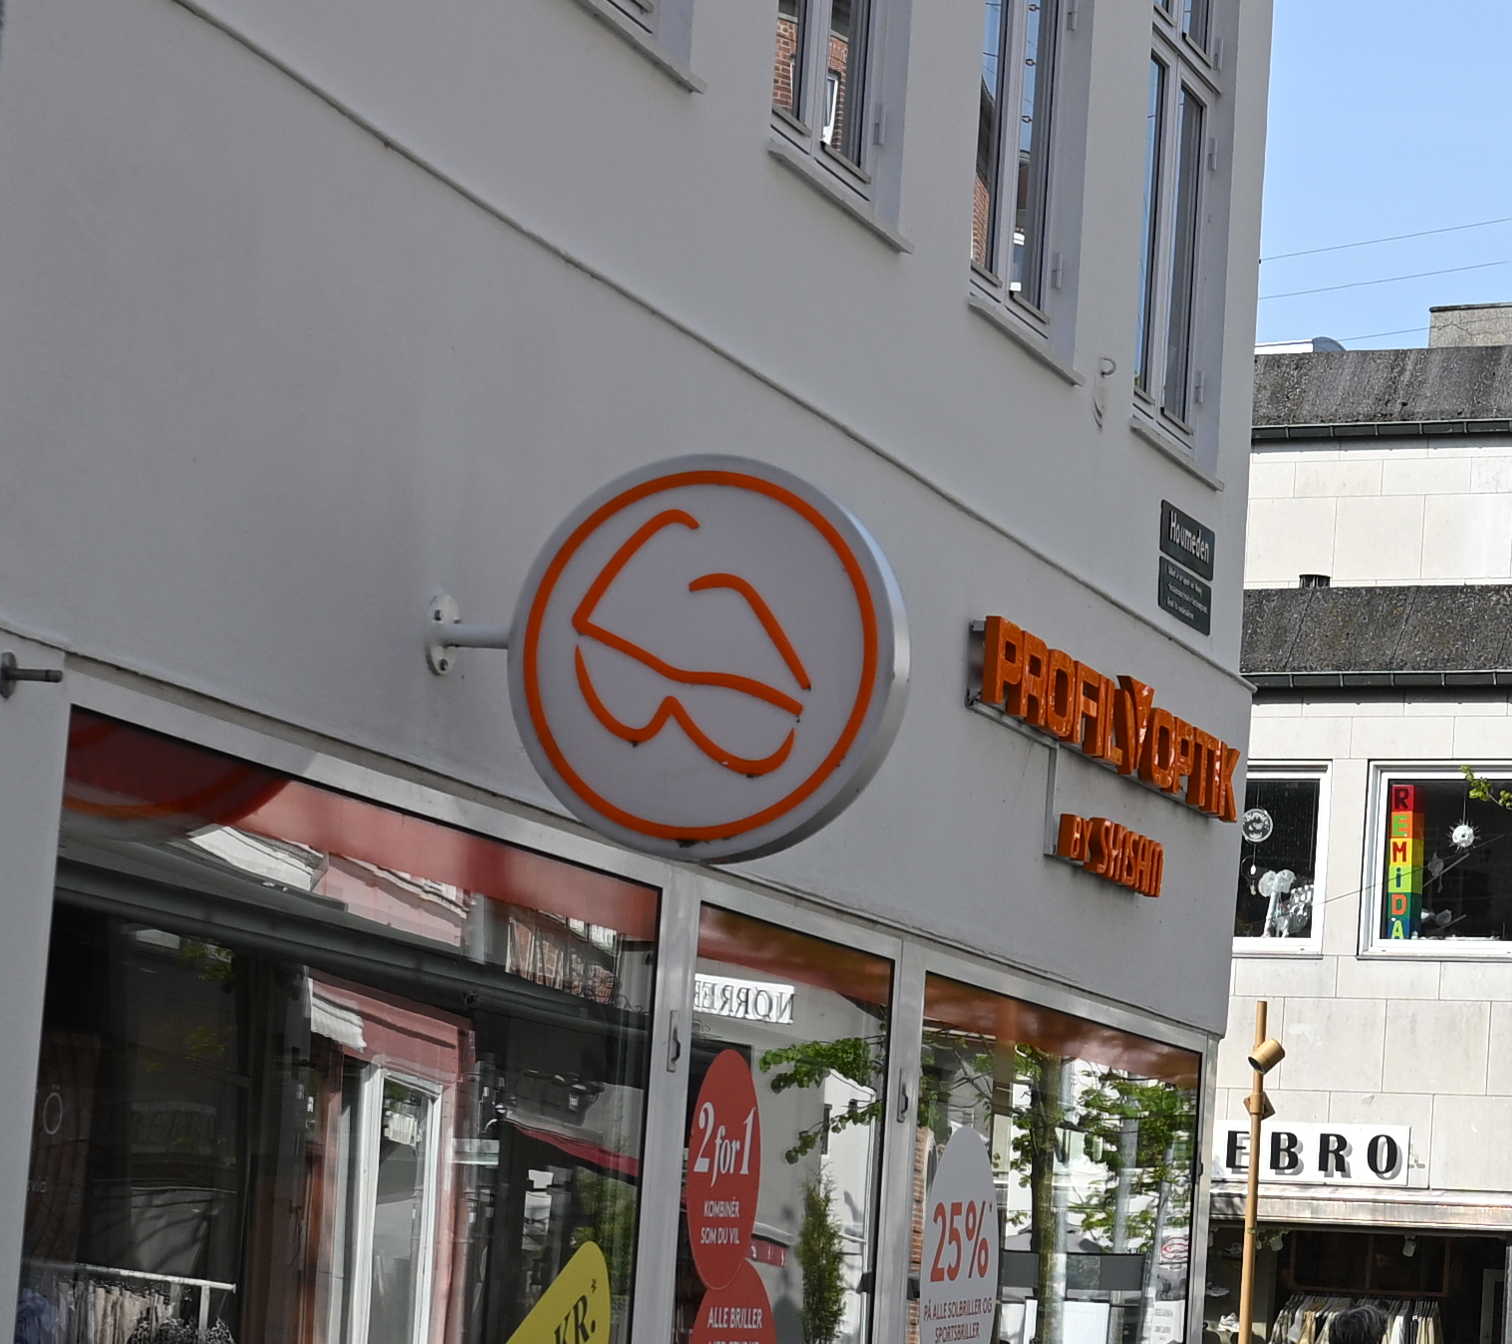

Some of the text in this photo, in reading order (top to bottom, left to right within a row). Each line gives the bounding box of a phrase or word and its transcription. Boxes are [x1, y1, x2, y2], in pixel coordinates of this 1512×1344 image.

[1170, 510, 1209, 565] Houmeden
[693, 1101, 757, 1187] 2 for 1
[708, 1306, 763, 1329] ALLE BRILLER
